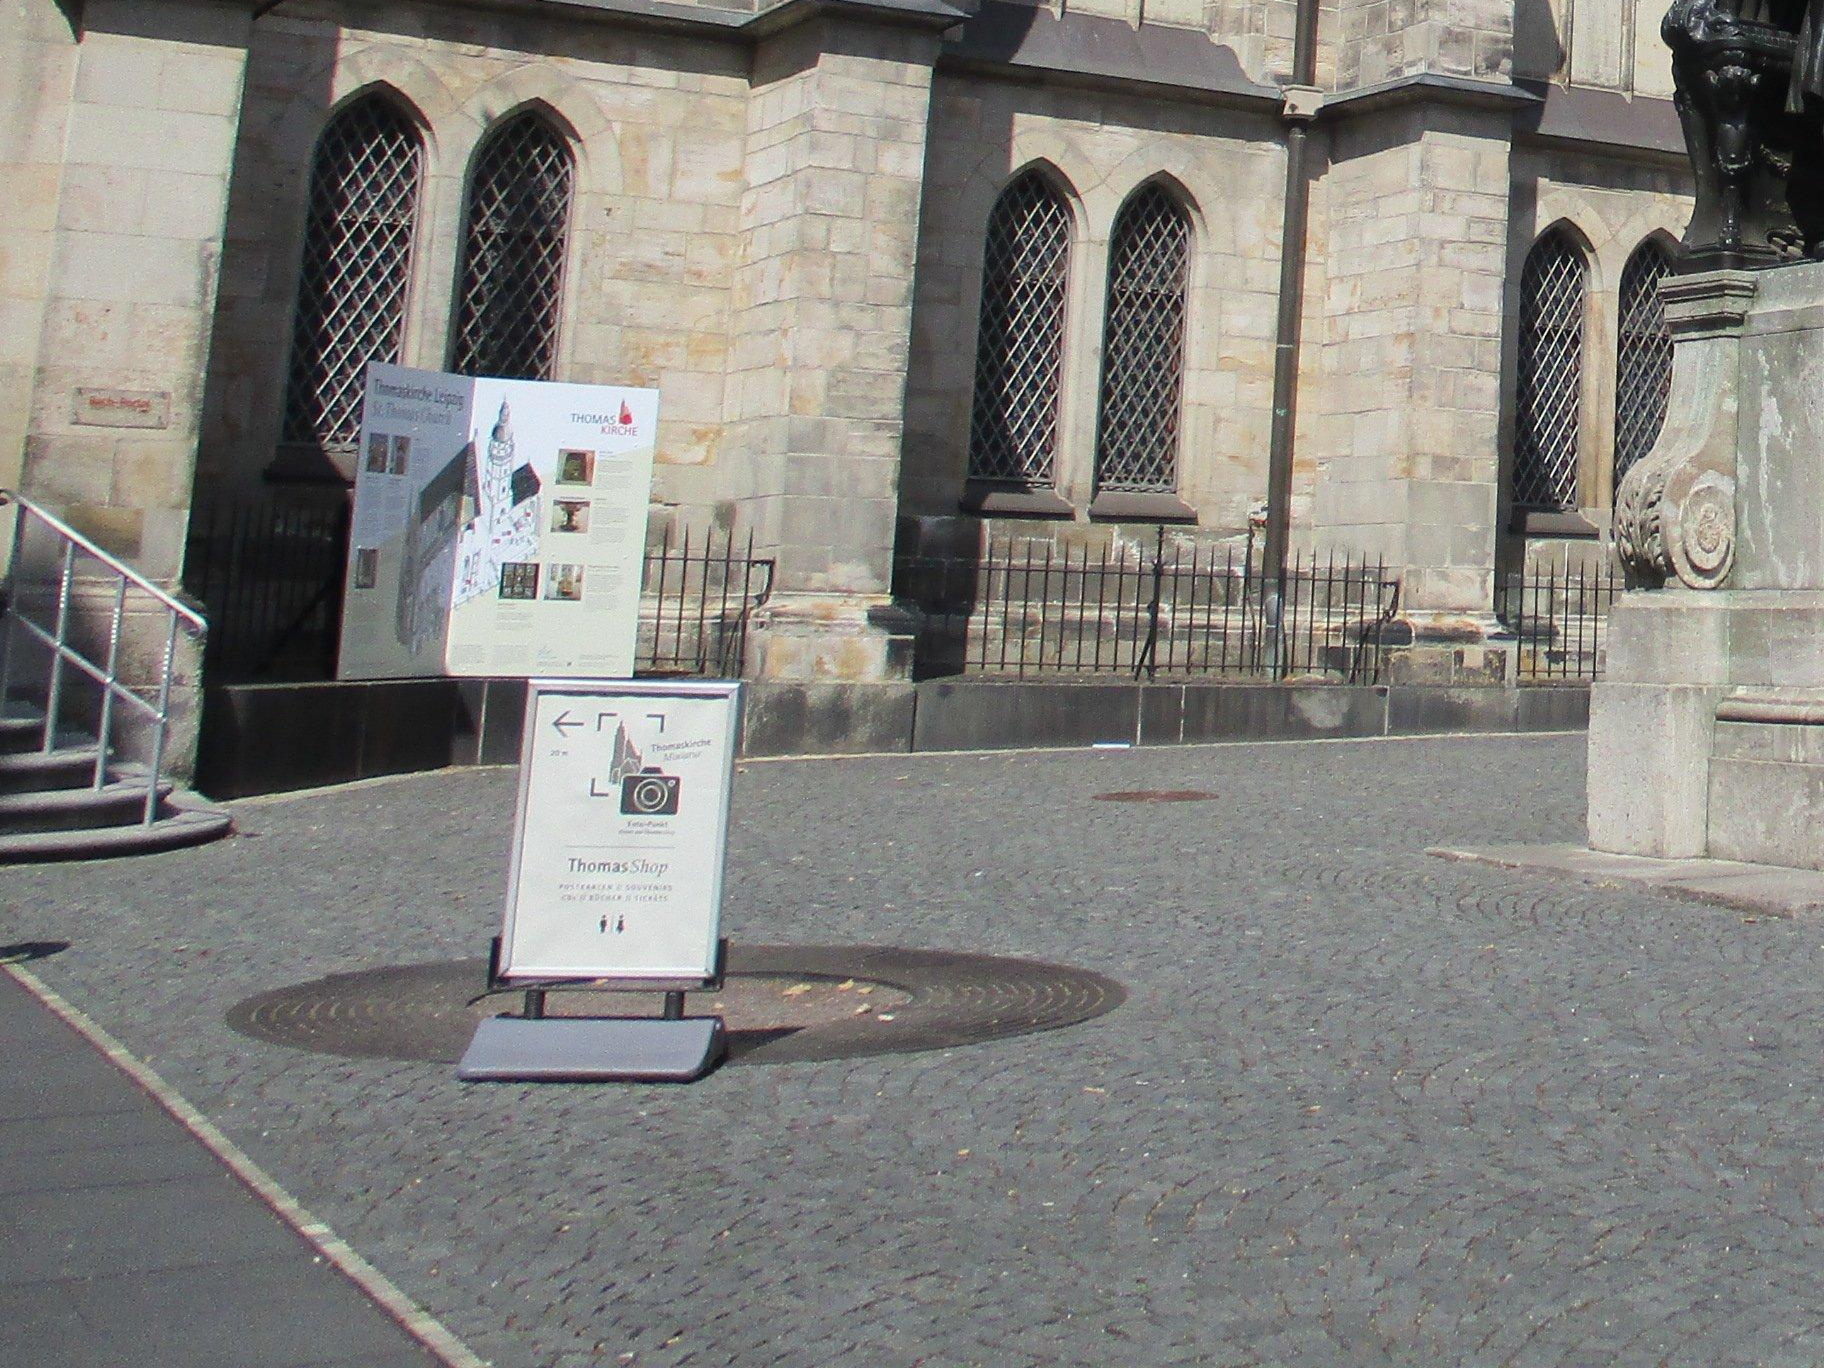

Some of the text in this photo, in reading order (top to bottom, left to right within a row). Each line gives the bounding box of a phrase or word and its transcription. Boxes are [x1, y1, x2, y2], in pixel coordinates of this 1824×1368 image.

[571, 413, 617, 425] THOMAS
[601, 425, 639, 436] KIRCHE
[651, 738, 713, 753] Thomaskirche
